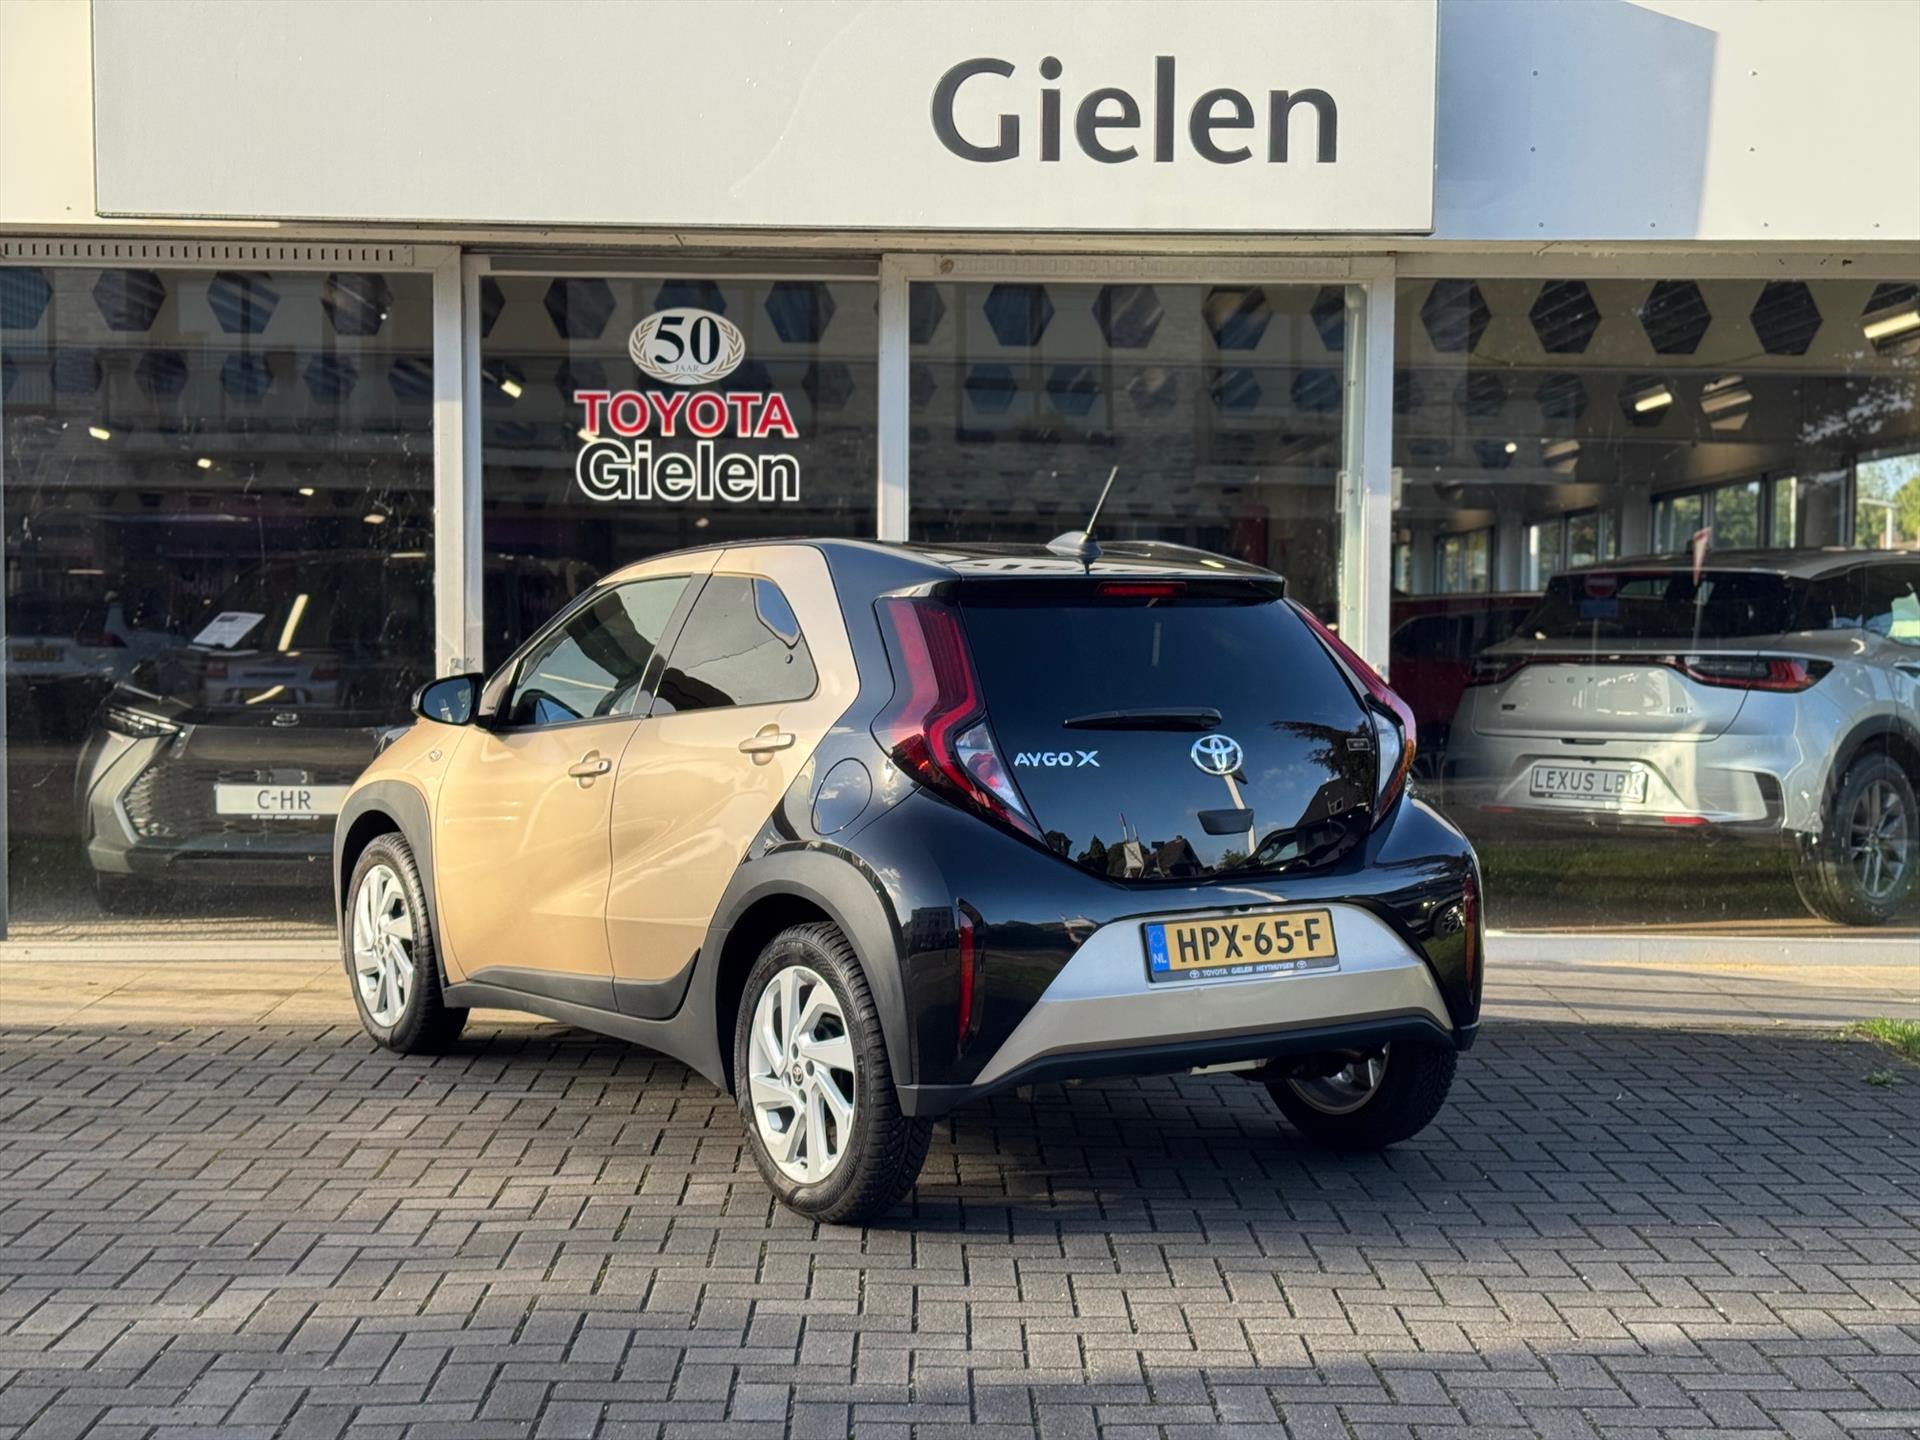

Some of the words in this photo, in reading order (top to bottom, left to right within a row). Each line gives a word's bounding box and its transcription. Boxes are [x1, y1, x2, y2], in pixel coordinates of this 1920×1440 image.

[931, 55, 1338, 164] Gielen
[654, 316, 721, 365] 50
[574, 390, 799, 438] TOYOTA
[576, 438, 800, 502] Gielen
[1014, 752, 1074, 767] AYGO
[257, 789, 312, 810] C-HR
[1534, 770, 1595, 792] LEXUS
[1603, 773, 1642, 795] LBX
[1177, 918, 1321, 963] HPX-65-F
[1153, 953, 1167, 964] NL
[1202, 967, 1229, 977] TOYOTA
